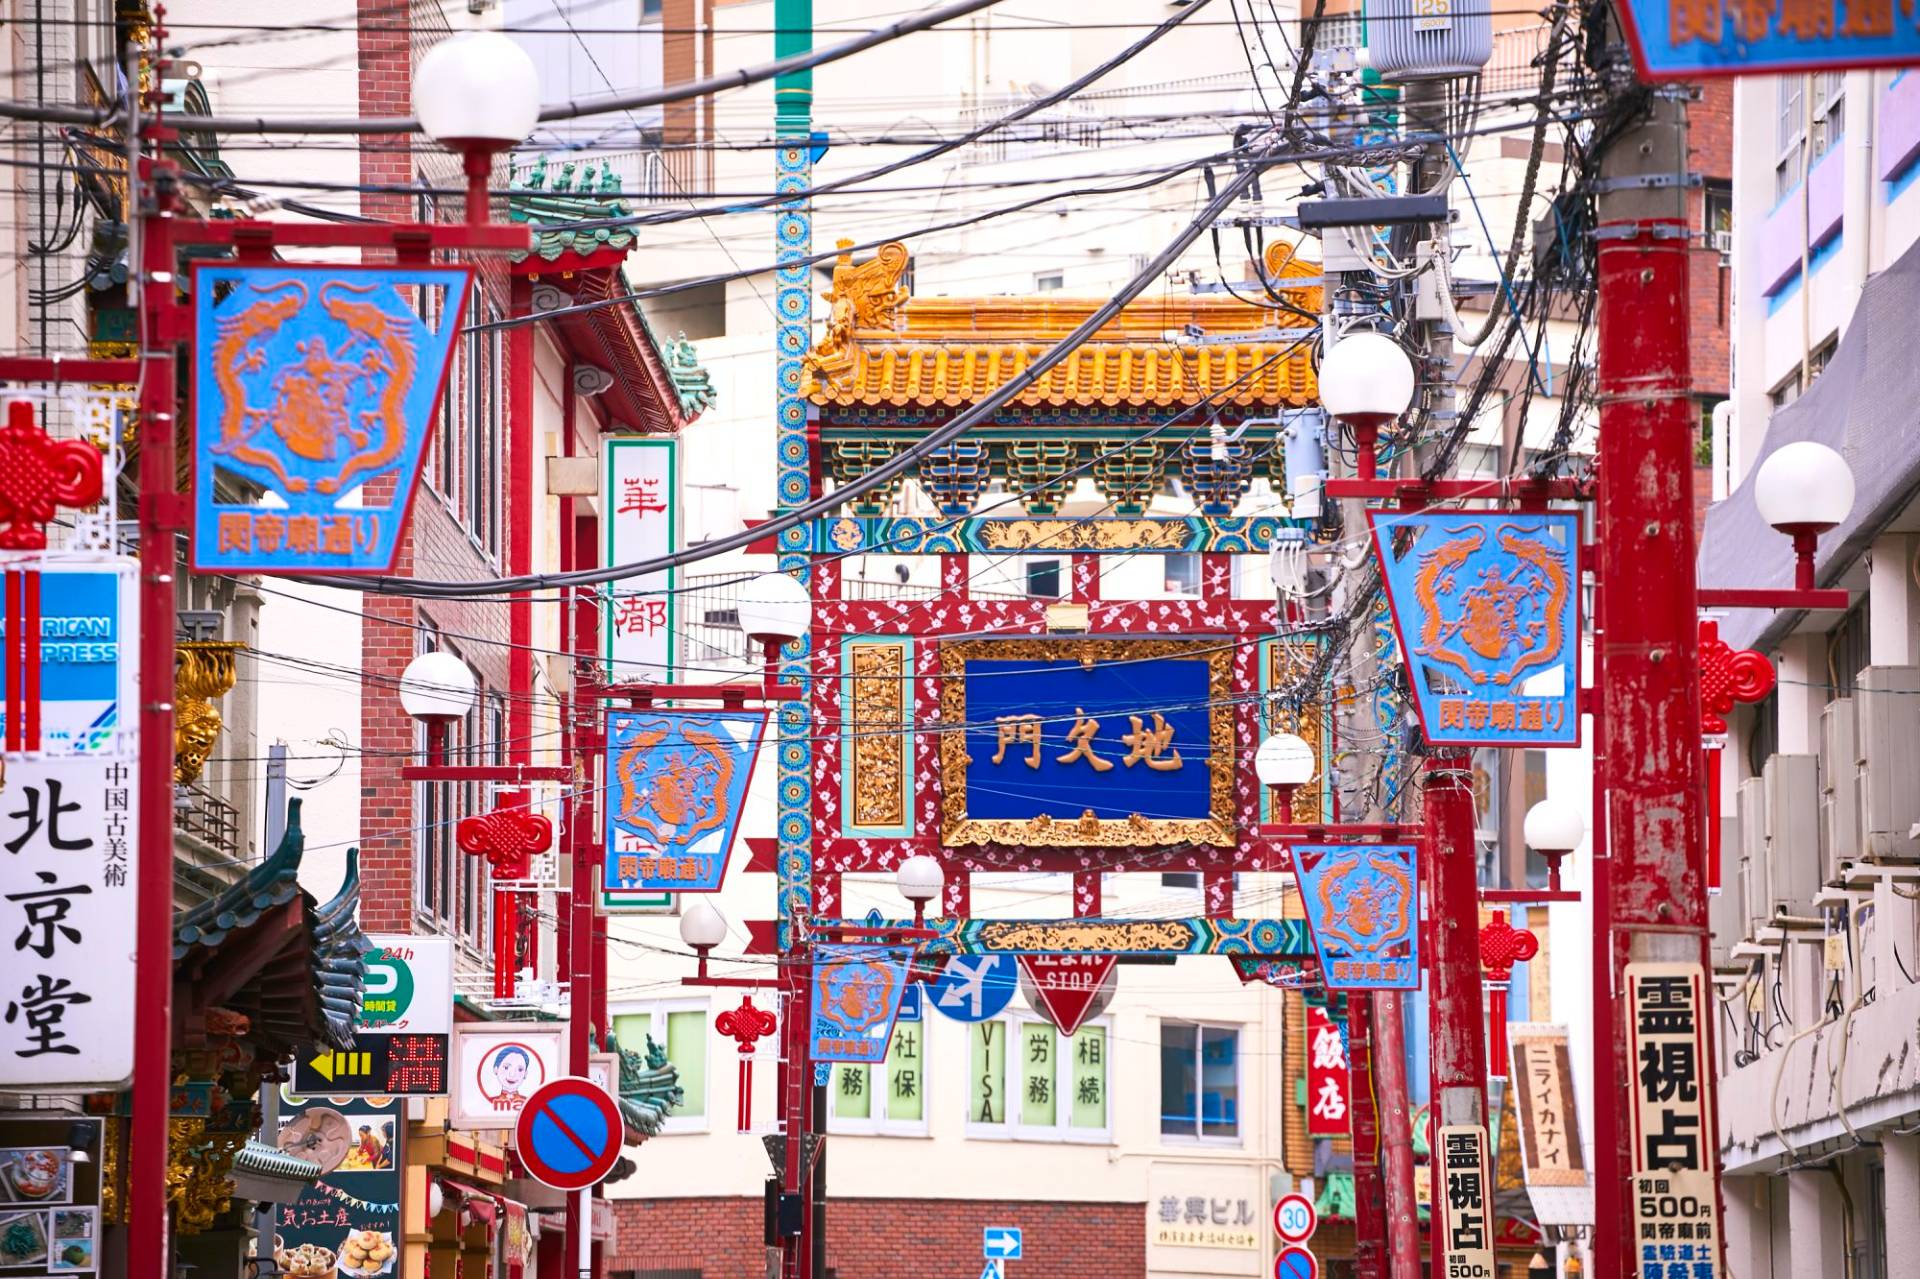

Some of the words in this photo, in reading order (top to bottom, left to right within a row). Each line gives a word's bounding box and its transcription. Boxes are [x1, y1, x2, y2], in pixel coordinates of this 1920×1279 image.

[218, 512, 378, 555] 関帝廟通り
[1439, 698, 1564, 731] 関帝廟通り
[104, 762, 128, 887] 中国古美術
[4, 778, 93, 1058] 北京堂
[381, 947, 414, 961] 24h
[1046, 971, 1093, 990] STOP
[388, 1036, 444, 1092] 満
[894, 1029, 917, 1098] 社保
[980, 1023, 993, 1122] VISA
[1028, 1033, 1049, 1104] 労務
[1077, 1037, 1101, 1105] 相続
[1638, 976, 1699, 1171] 霊視占
[1531, 1049, 1561, 1166] ニライカナイ
[1447, 1133, 1483, 1250] 霊視占
[1638, 1179, 1670, 1194] 初回
[1640, 1196, 1711, 1218] 500円
[275, 1207, 352, 1230] 気お土産
[1283, 1207, 1306, 1230] 30
[1450, 1265, 1490, 1278] 500円
